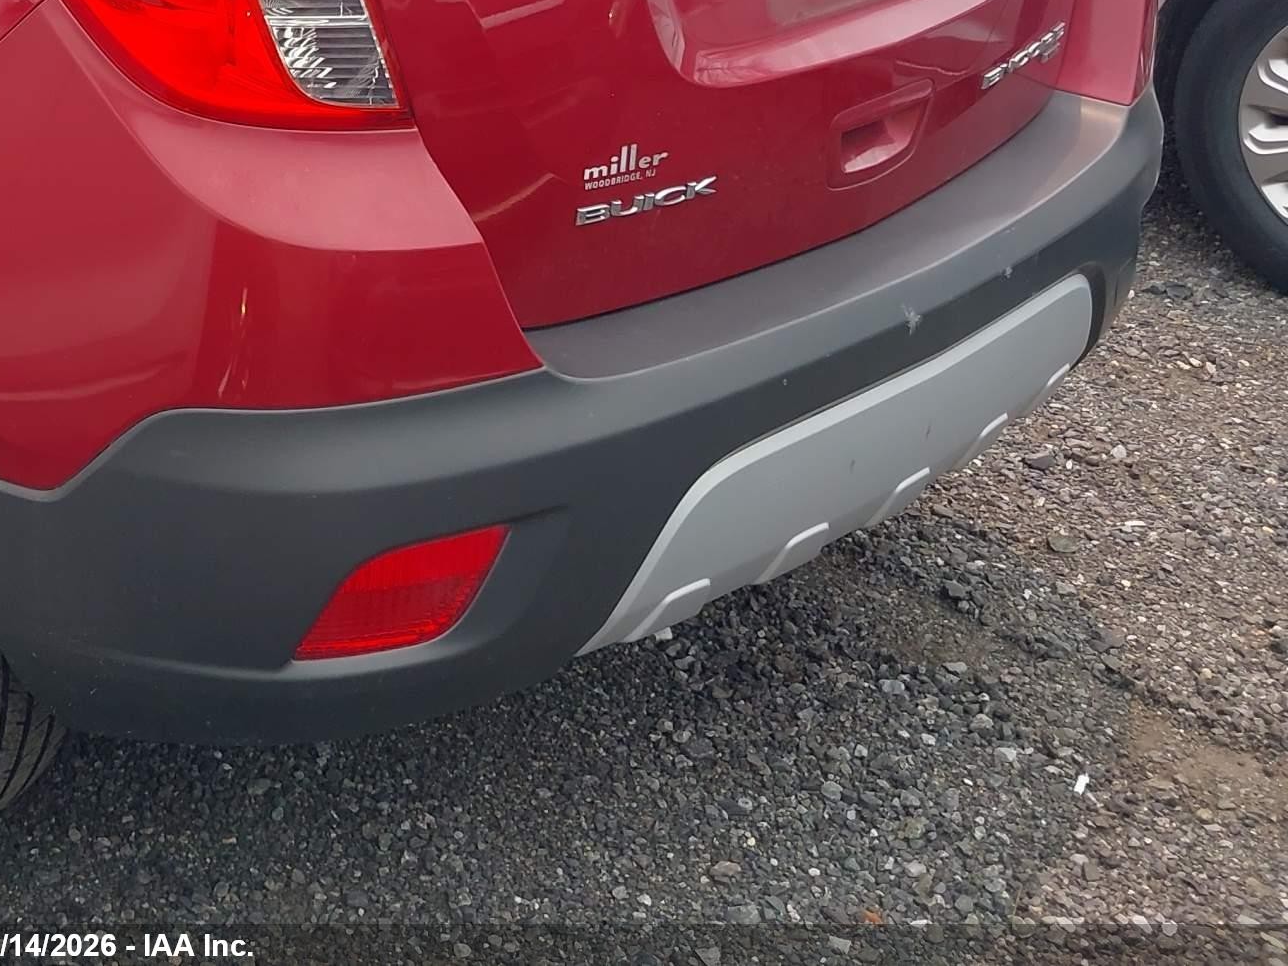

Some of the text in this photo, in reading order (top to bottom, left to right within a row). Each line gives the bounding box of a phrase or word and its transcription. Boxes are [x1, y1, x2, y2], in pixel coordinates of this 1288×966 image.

[583, 143, 669, 180] miller
[645, 169, 656, 179] NJ
[575, 176, 717, 226] BUICK
